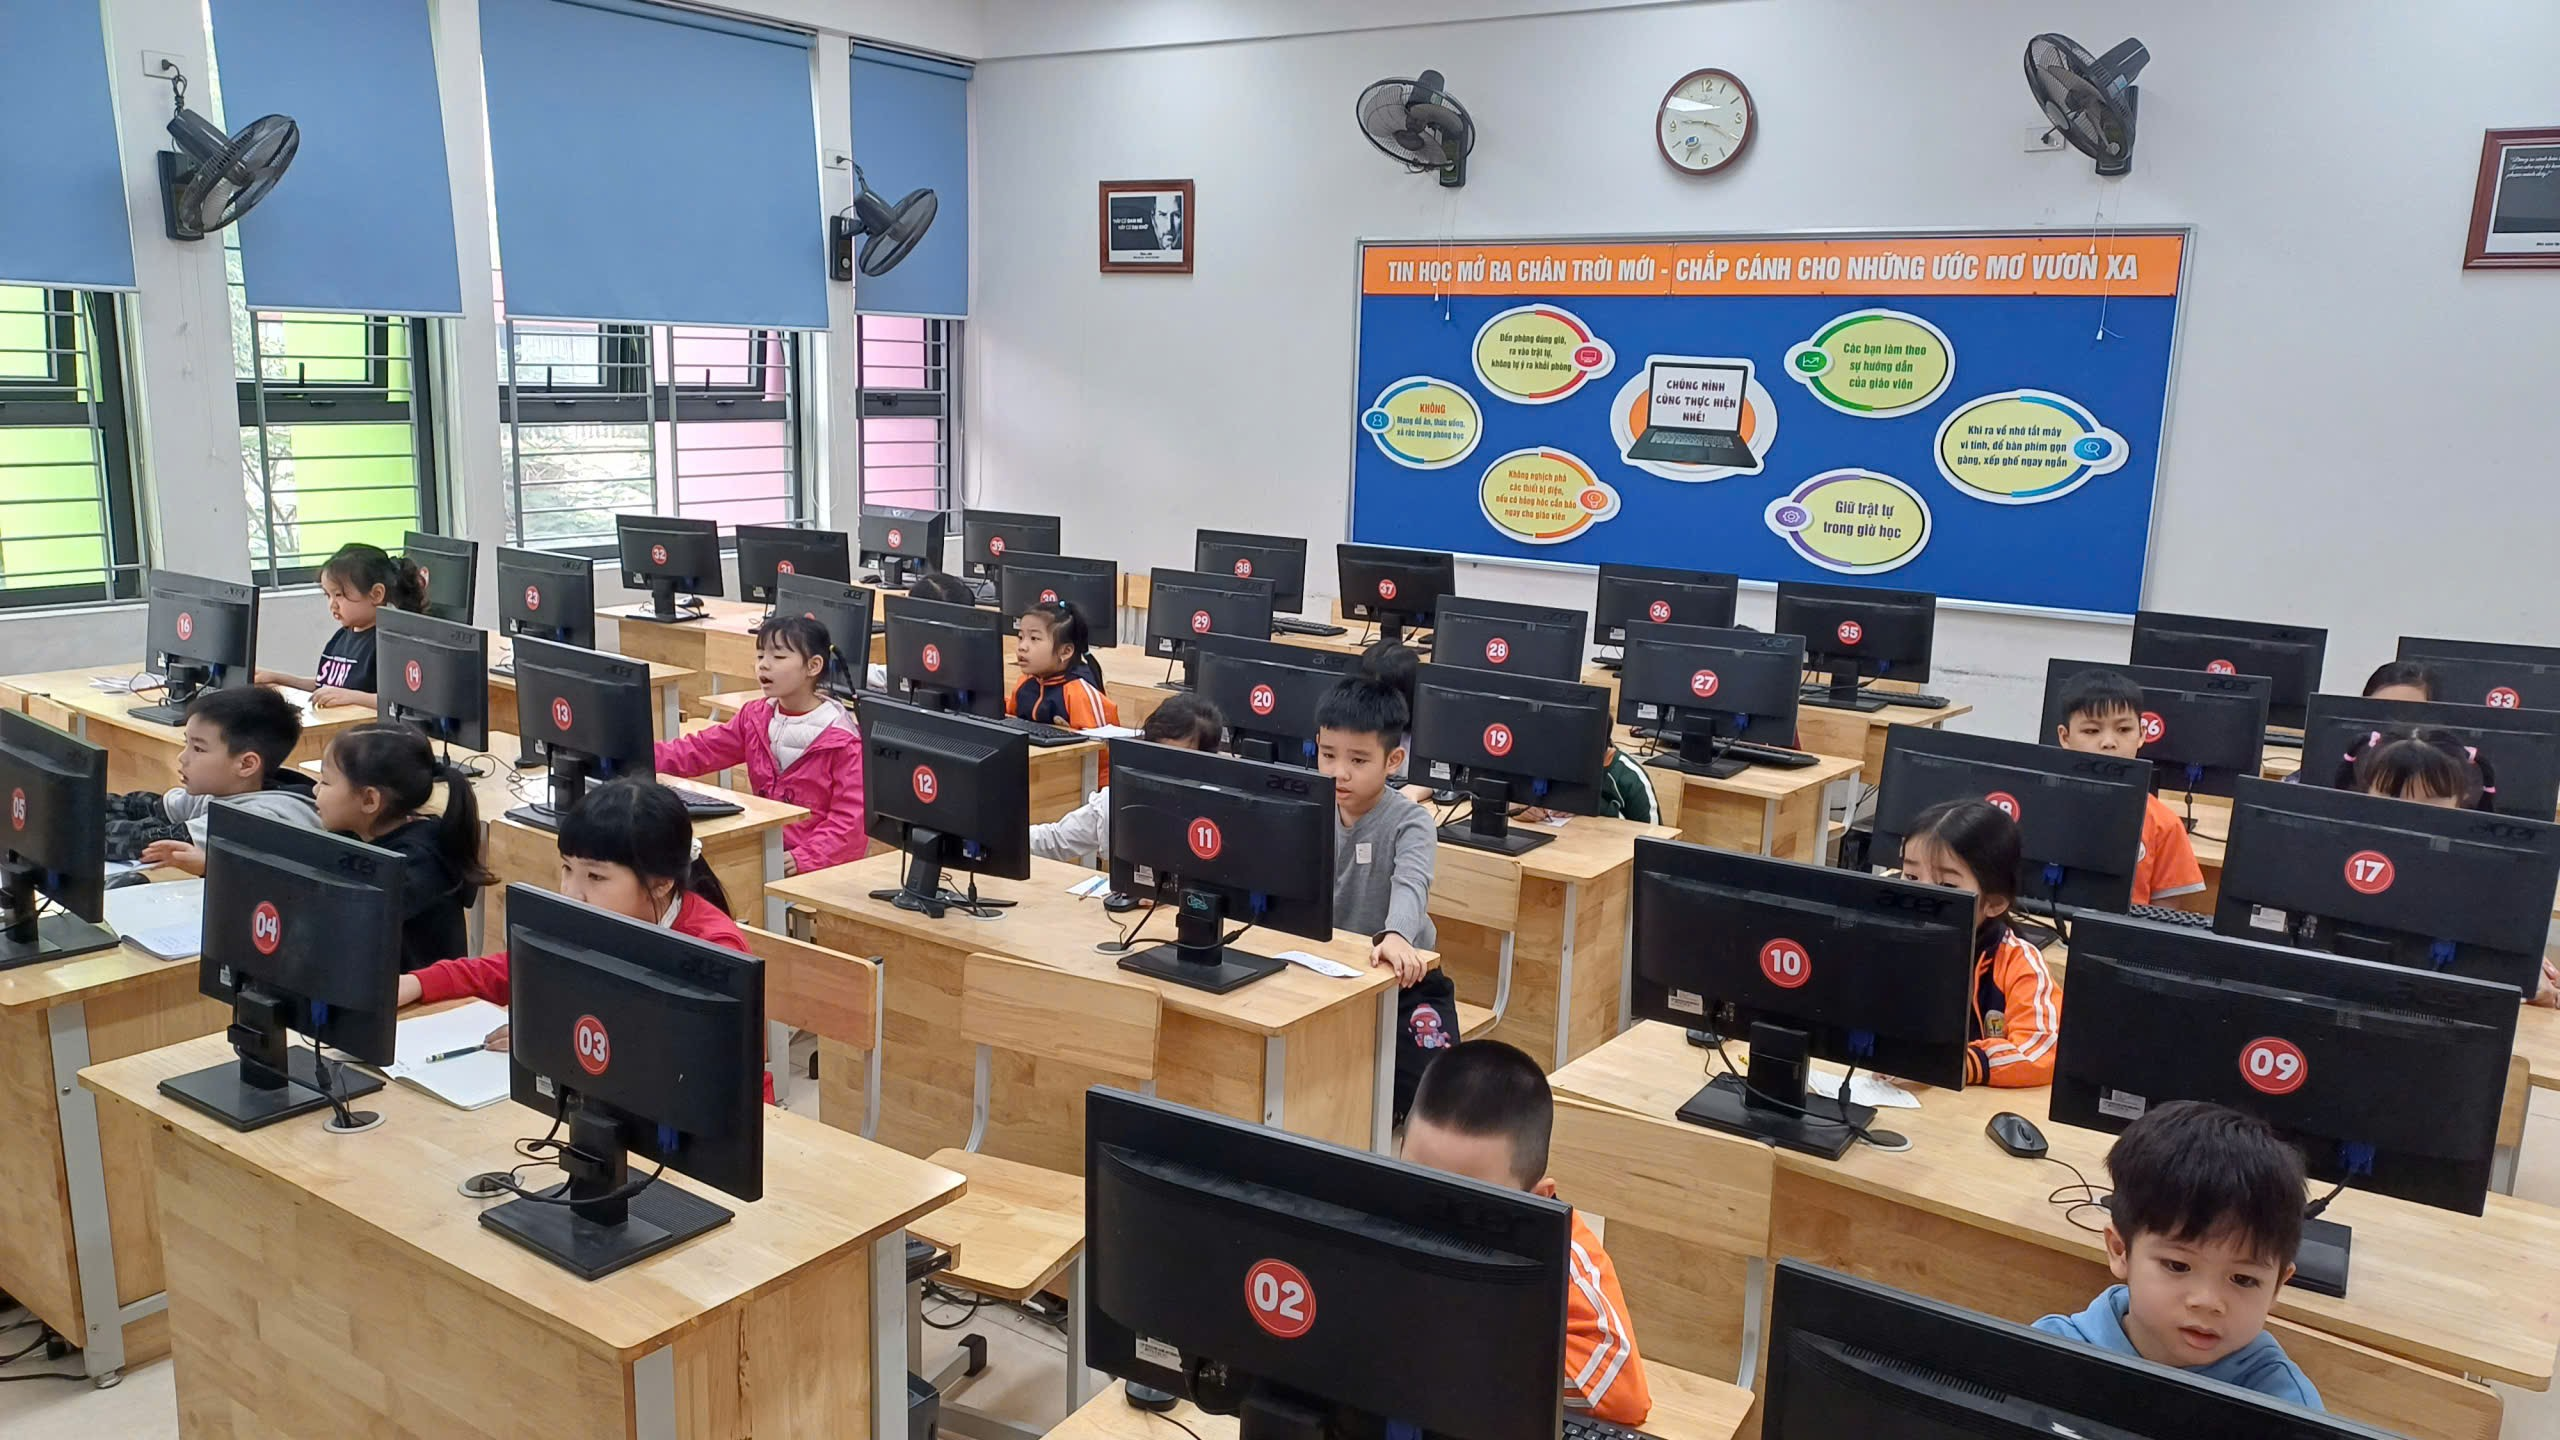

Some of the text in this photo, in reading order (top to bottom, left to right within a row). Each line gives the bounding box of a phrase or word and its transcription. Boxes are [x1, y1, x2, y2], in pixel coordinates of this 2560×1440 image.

[1702, 80, 1713, 92] 12
[1735, 112, 1743, 124] 3
[1701, 153, 1709, 165] 6
[1389, 260, 1413, 282] TIN
[1418, 260, 1452, 286] HỌC
[1457, 254, 1485, 282] MỞ
[1489, 260, 1512, 282] RA
[1517, 256, 1567, 282] CHÂN
[1572, 254, 1612, 281] TRỜI
[1617, 254, 1655, 281] MỚI
[1676, 250, 1730, 281] CHẮP
[1735, 252, 1791, 281] CÁNH
[1797, 256, 1841, 280] CHO
[1847, 251, 1926, 280] NHỮNG
[1932, 251, 1979, 280] ƯỚC
[1985, 252, 2027, 280] MƠ
[2032, 252, 2098, 280] VƯƠN
[2104, 254, 2138, 280] XA
[1514, 334, 1534, 344] phòng
[1518, 348, 1529, 356] vào
[1844, 343, 1926, 356] Các bạn làm theo
[1491, 360, 1511, 369] không
[1535, 361, 1549, 370] khỏi
[1551, 362, 1571, 372] phòng
[1850, 360, 1913, 373] sự hướng dẫn
[1666, 378, 1725, 391] CHÚNG MÌNH
[1849, 376, 1912, 390] của giáo viên
[1420, 402, 1446, 414] KHÔNG
[1656, 393, 1736, 410] CÙNG THỰC HIỆN
[1397, 416, 1413, 425] Mang
[1682, 411, 1706, 422] NHÉ!
[1416, 430, 1432, 438] trong
[1433, 431, 1451, 440] phòng
[1453, 432, 1464, 442] học
[1968, 426, 1982, 434] Khi
[1996, 425, 2007, 435] về
[2009, 427, 2026, 436] nhớ
[2028, 425, 2040, 436] tắt
[2042, 427, 2062, 437] máy
[1970, 440, 1990, 450] tính,
[2006, 442, 2022, 450] bàn
[2024, 442, 2047, 452] phím
[2050, 444, 2066, 454] gọn
[1958, 454, 2067, 468] gàng, xếp ghế ngay ngắn
[1508, 470, 1528, 480] Không
[1531, 472, 1552, 482] nghịch
[1505, 509, 1520, 518] ngay
[1522, 510, 1533, 518] cho
[1836, 500, 1894, 520] Giữ trật tự
[1824, 521, 1902, 540] trong giờ học
[991, 541, 1004, 550] 39
[654, 549, 667, 561] 32
[1237, 562, 1250, 574] 38
[843, 588, 865, 600] acer
[1380, 583, 1394, 595] 37
[527, 591, 538, 604] 23
[1652, 605, 1668, 618] 36
[178, 619, 190, 633] 16
[1194, 616, 1208, 628] 29
[1840, 626, 1859, 639] 35
[926, 650, 937, 664] 21
[1489, 644, 1506, 657] 28
[409, 667, 418, 683] 14
[1693, 674, 1715, 690] 27
[1253, 691, 1271, 708] 20
[2490, 692, 2512, 708] 33
[556, 704, 569, 722] 13
[1490, 730, 1508, 748] 19
[917, 773, 933, 794] 12
[1264, 774, 1311, 796] acer
[13, 797, 24, 820] 05
[1197, 827, 1212, 849] 11
[2354, 860, 2386, 882] 17
[255, 912, 277, 942] 04
[1770, 949, 1801, 976] 10
[579, 1026, 607, 1062] 03
[2250, 1048, 2299, 1081] 09
[1254, 1272, 1305, 1321] 02
